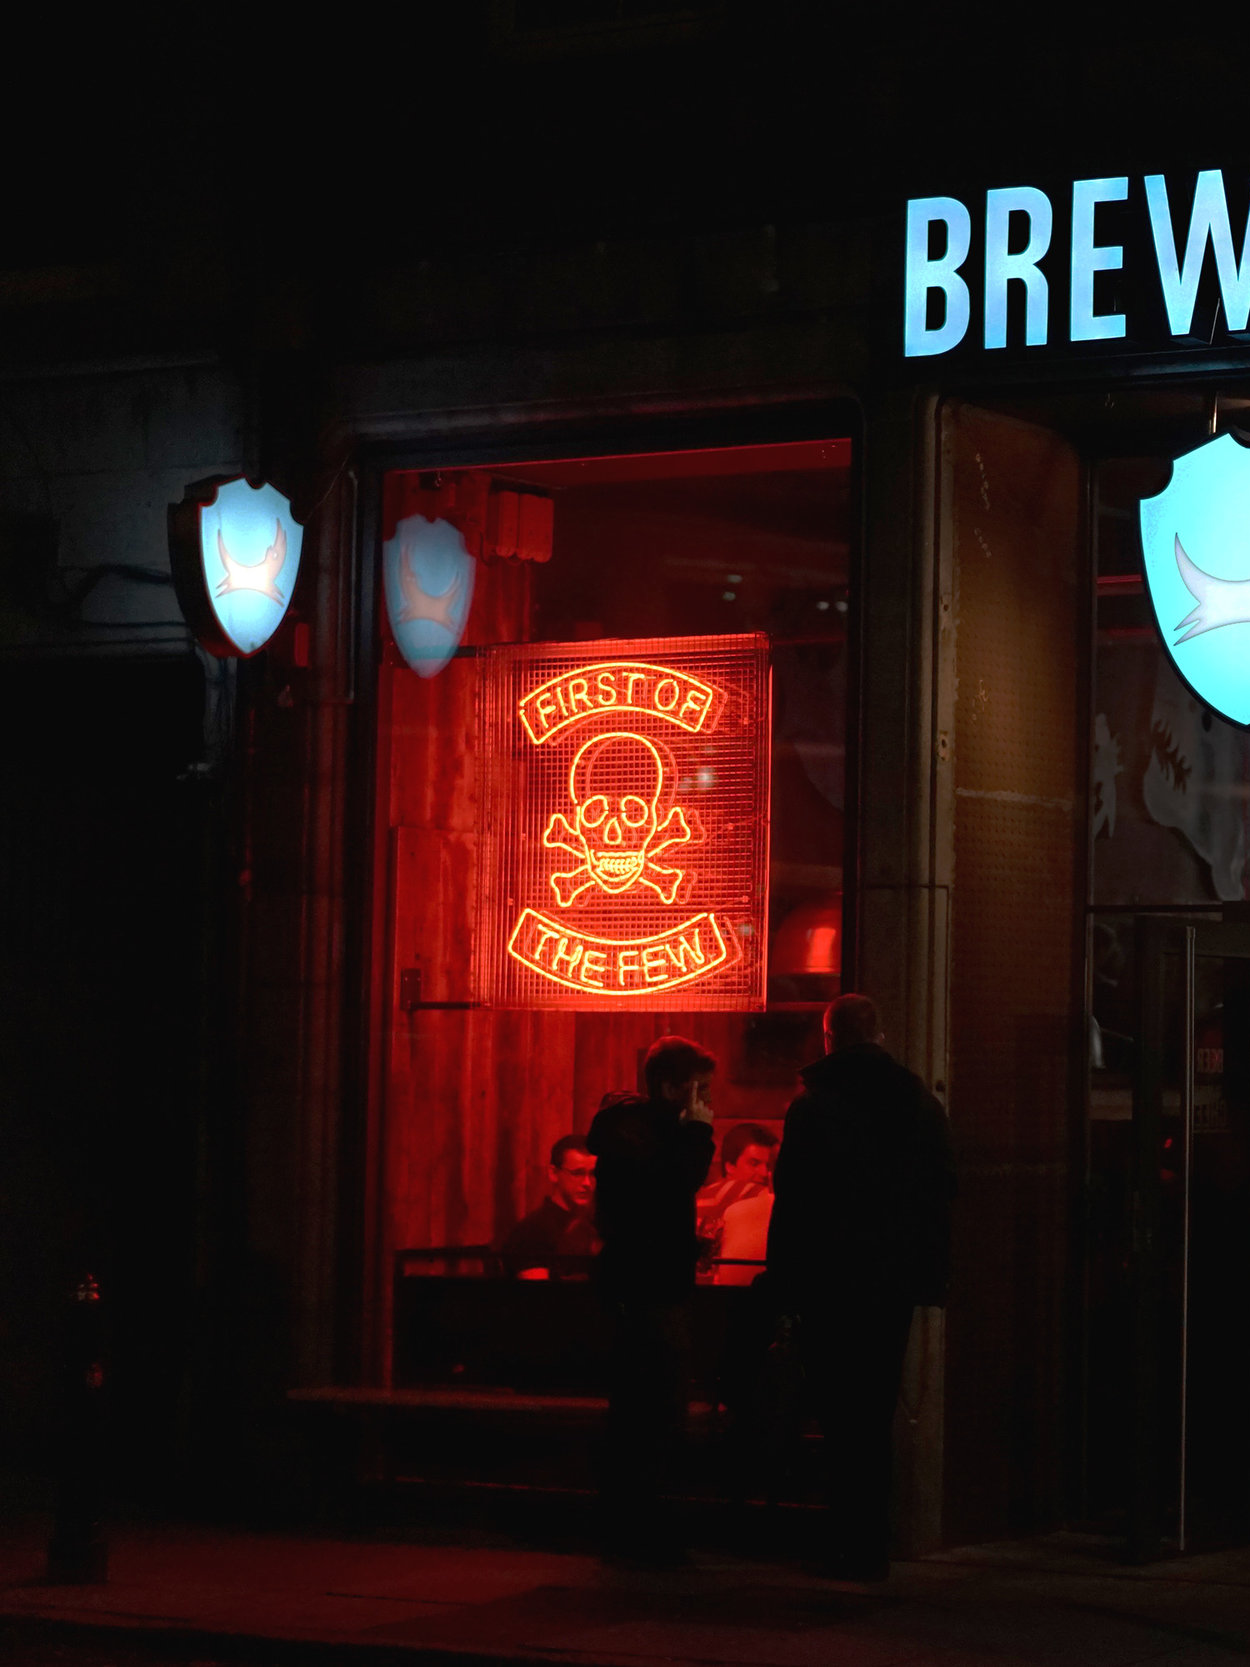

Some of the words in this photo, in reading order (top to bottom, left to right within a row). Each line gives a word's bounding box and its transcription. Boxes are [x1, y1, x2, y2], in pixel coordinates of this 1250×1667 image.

[535, 672, 646, 728] FIRST
[654, 678, 707, 719] OF
[534, 923, 607, 987] THE
[617, 928, 706, 986] FEW
